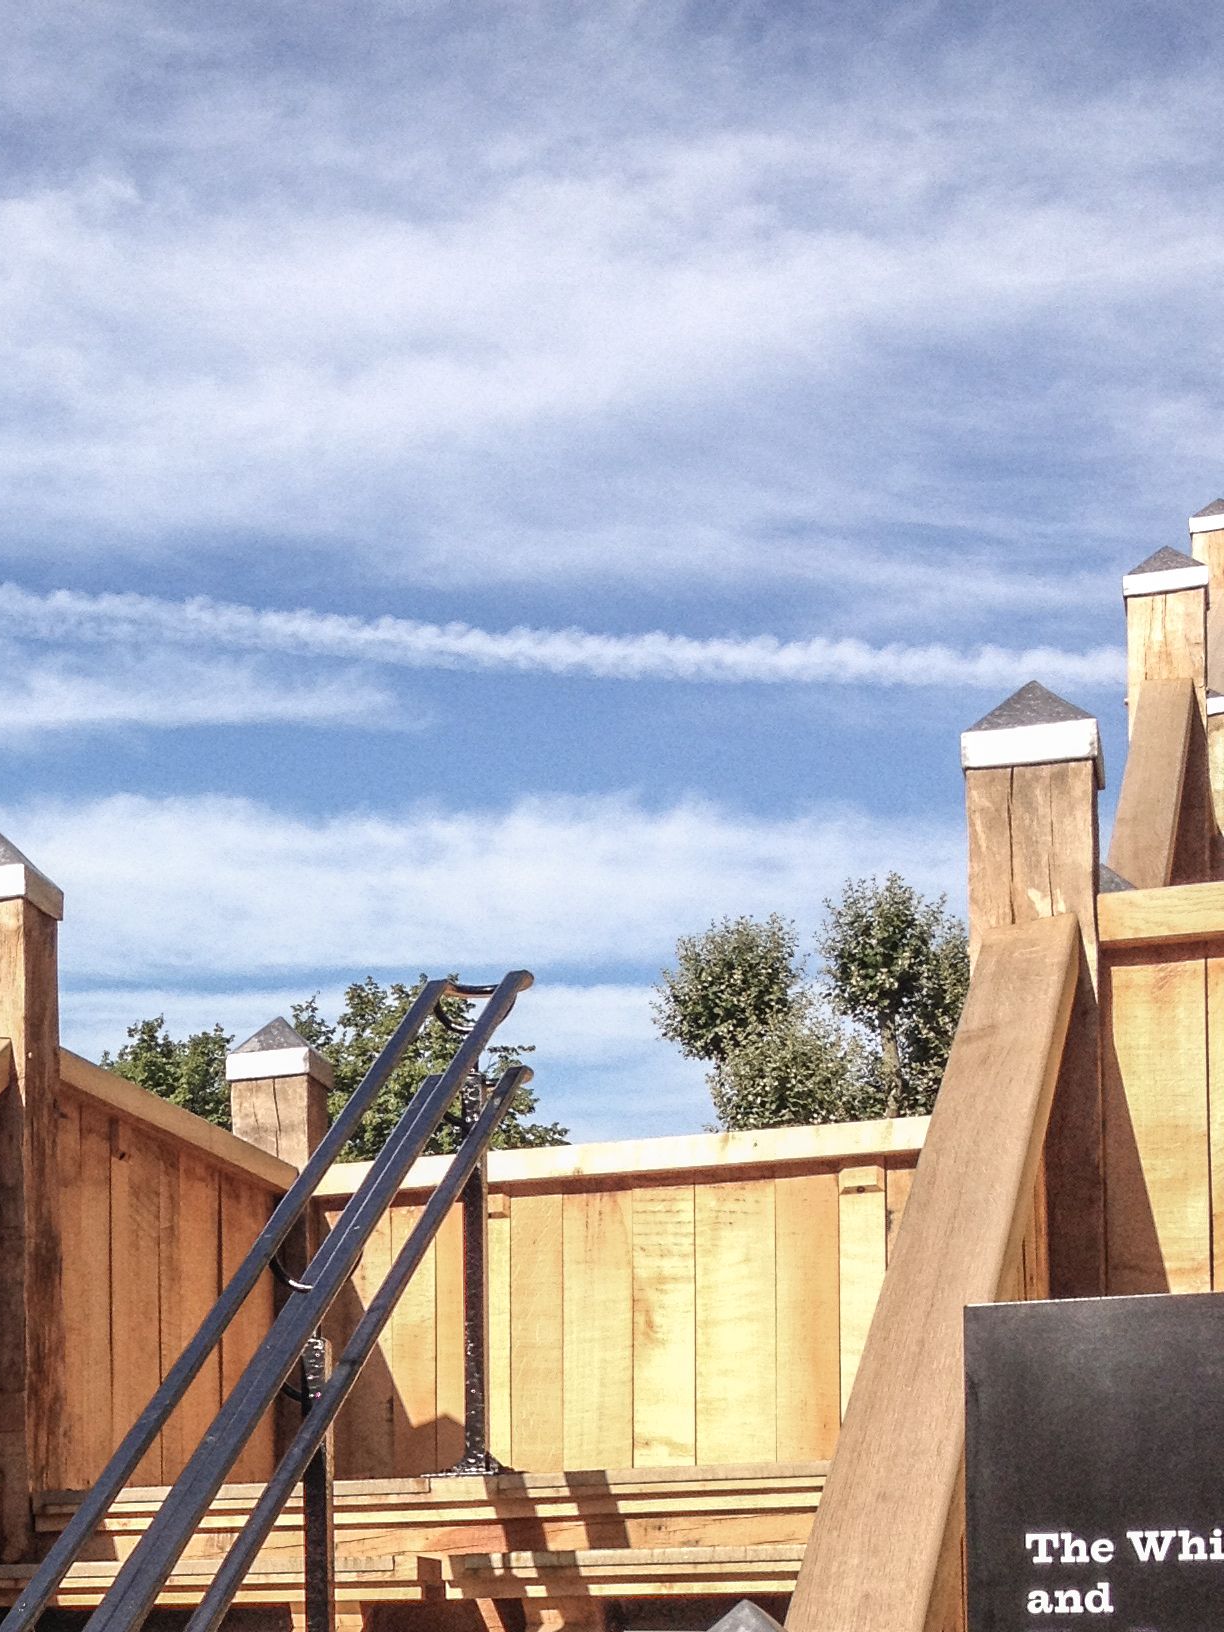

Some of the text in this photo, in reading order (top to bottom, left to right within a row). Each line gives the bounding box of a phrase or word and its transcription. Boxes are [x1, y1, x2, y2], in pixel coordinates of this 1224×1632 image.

[1025, 1528, 1224, 1564] The Whi
[1026, 1581, 1115, 1614] and
